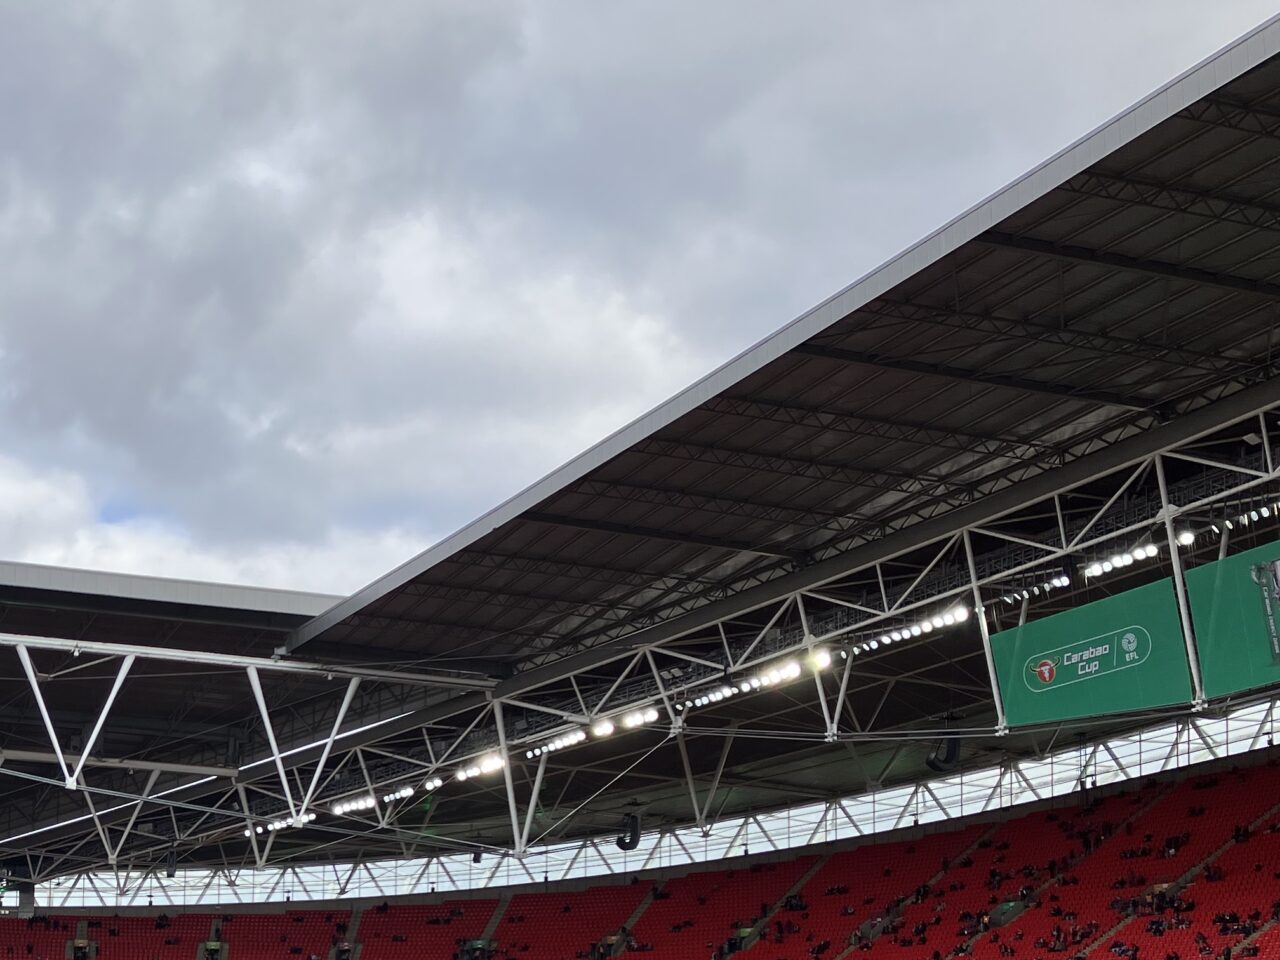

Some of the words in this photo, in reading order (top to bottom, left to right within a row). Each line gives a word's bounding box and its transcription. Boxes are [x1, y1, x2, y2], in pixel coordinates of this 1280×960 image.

[1063, 644, 1109, 666] Carabao
[1125, 651, 1139, 662] EFL
[1078, 661, 1099, 675] Cup
